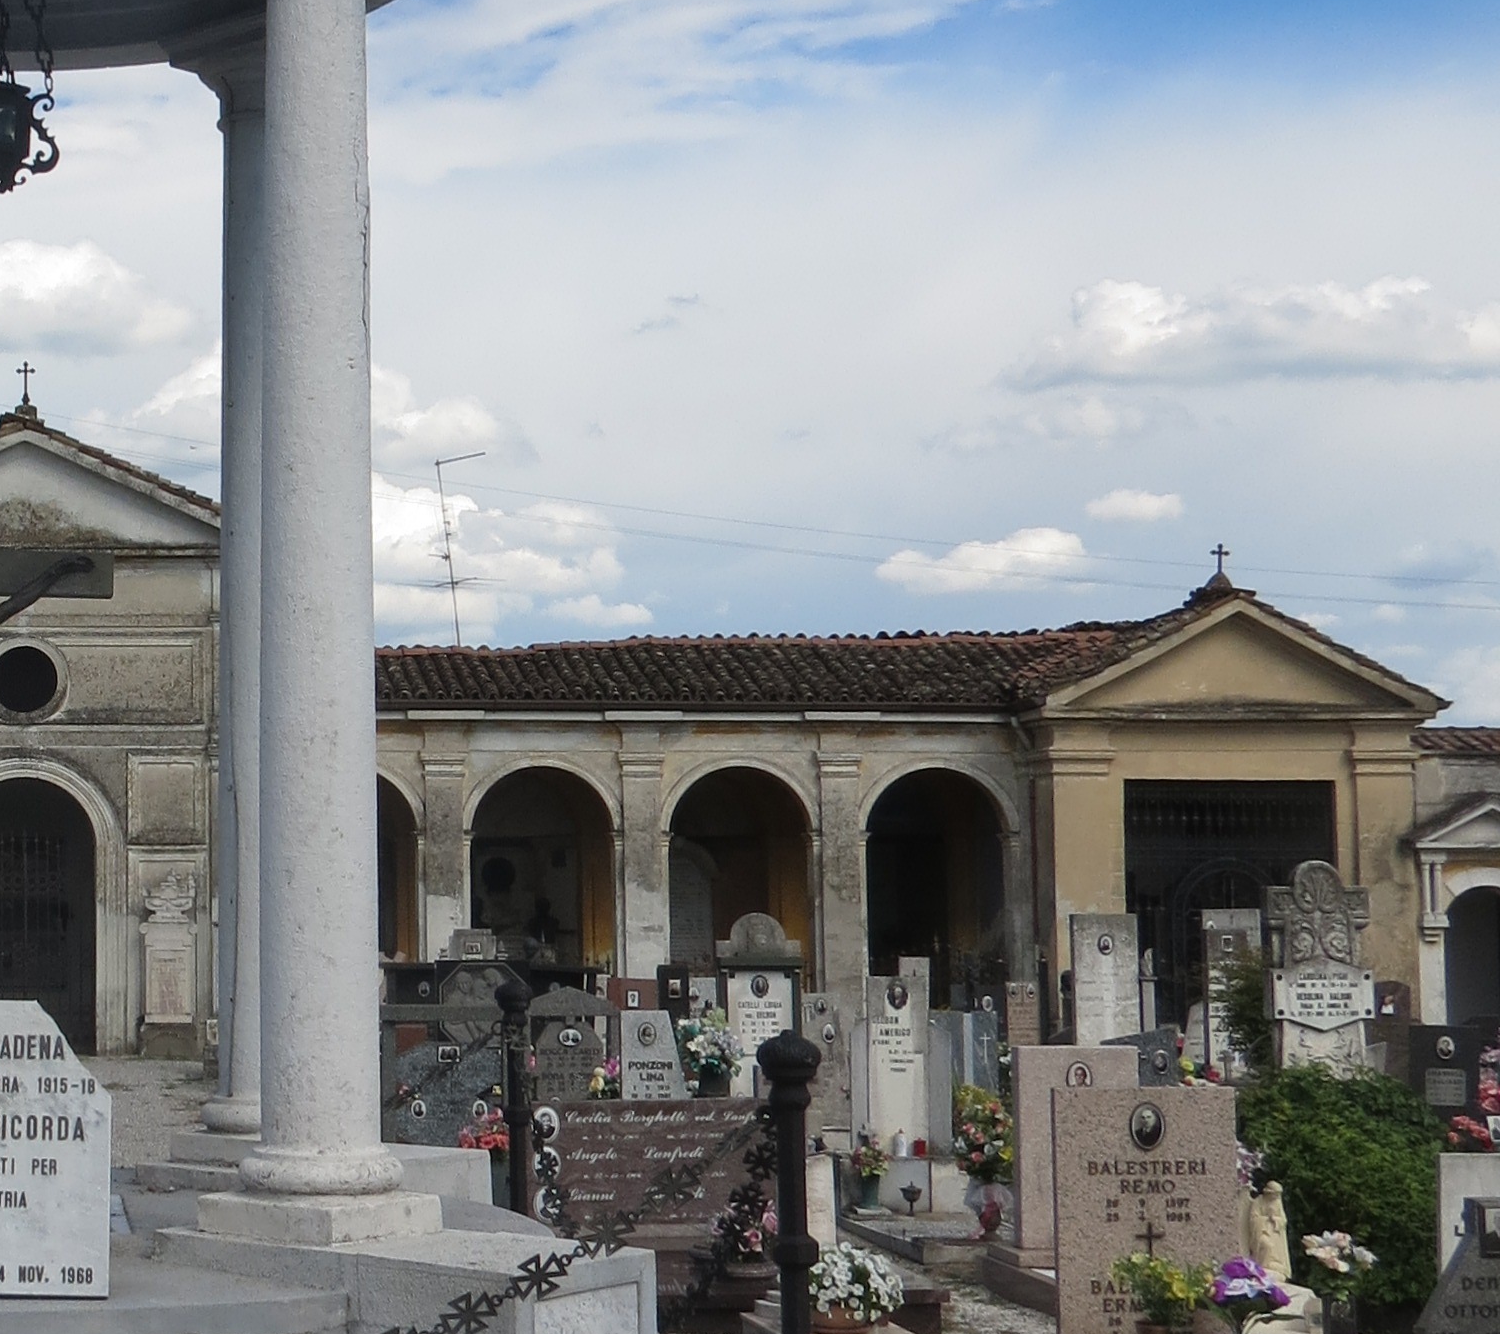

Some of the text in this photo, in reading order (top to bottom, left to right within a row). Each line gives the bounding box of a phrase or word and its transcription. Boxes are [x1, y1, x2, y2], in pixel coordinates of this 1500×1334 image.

[628, 1060, 674, 1071] PONZONI
[37, 1076, 96, 1095] 1915-18
[639, 1072, 665, 1082] LINA
[565, 1110, 612, 1123] Cecilia
[619, 1110, 687, 1127] Borghetti
[566, 1147, 705, 1164] Angelo Lanfredi
[31, 1157, 58, 1176] PER
[1087, 1159, 1207, 1176] BALESTRERI
[1120, 1179, 1176, 1194] REMO
[568, 1189, 617, 1202] Gianni
[18, 1266, 50, 1283] NOV.
[60, 1266, 94, 1284] 1968
